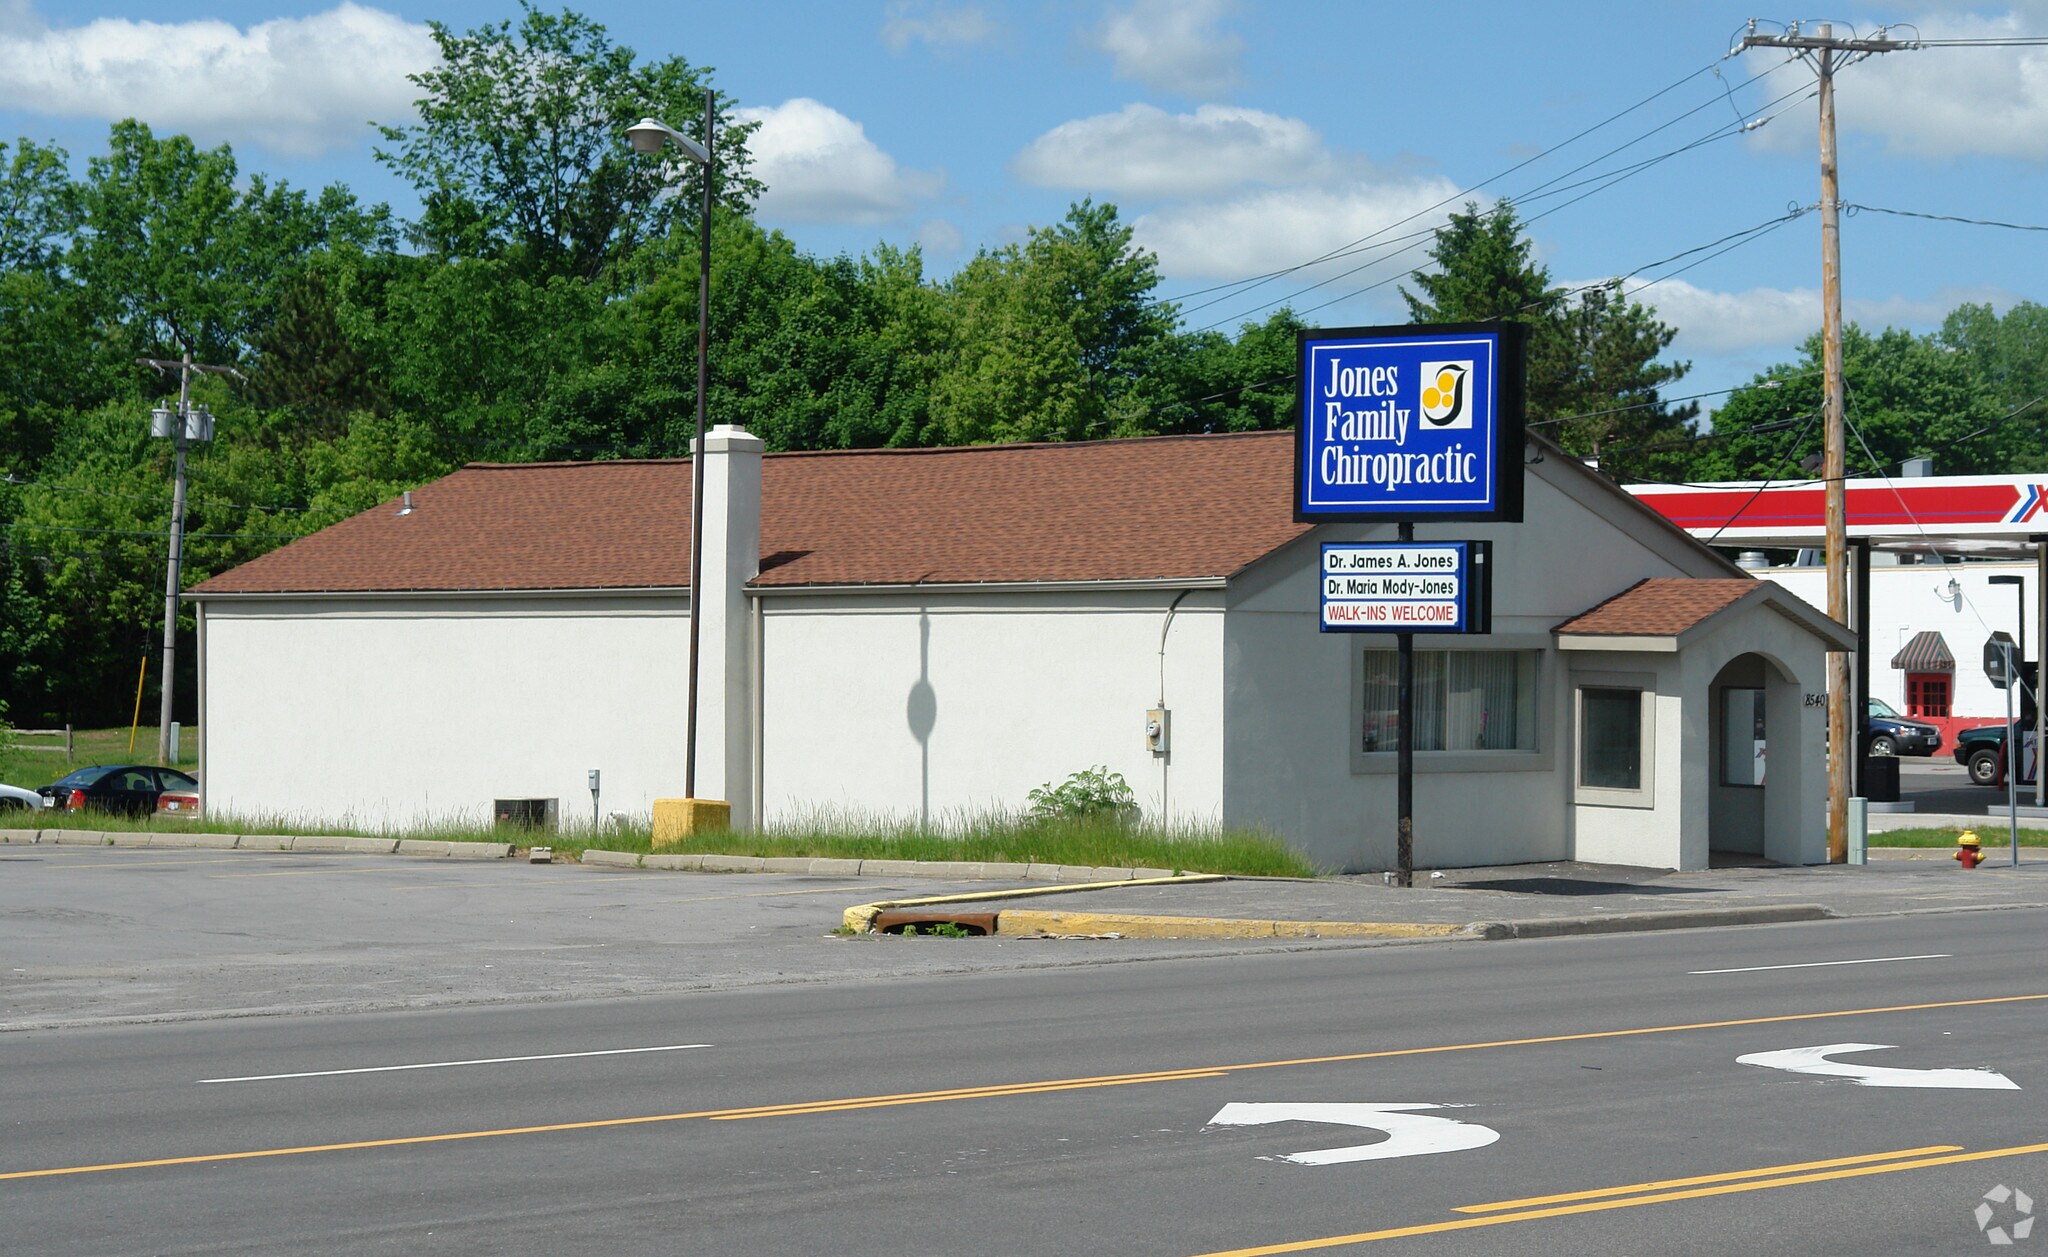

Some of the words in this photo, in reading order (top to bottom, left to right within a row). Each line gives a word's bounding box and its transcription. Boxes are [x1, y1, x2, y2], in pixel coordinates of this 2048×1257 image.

[1324, 358, 1399, 398] Jones
[1324, 400, 1411, 447] Family
[1321, 443, 1477, 492] Chiropractic
[1329, 554, 1347, 569] Dr.
[1349, 554, 1393, 569] James
[1397, 553, 1411, 568] A.
[1413, 553, 1453, 568] Jones
[1328, 579, 1343, 595] Dr.
[1346, 579, 1378, 595] Maria
[1382, 578, 1454, 597] Mody-Jones
[1327, 605, 1387, 621] WALK-INS
[1391, 605, 1454, 621] WELCOME
[1805, 693, 1826, 707] 8540
